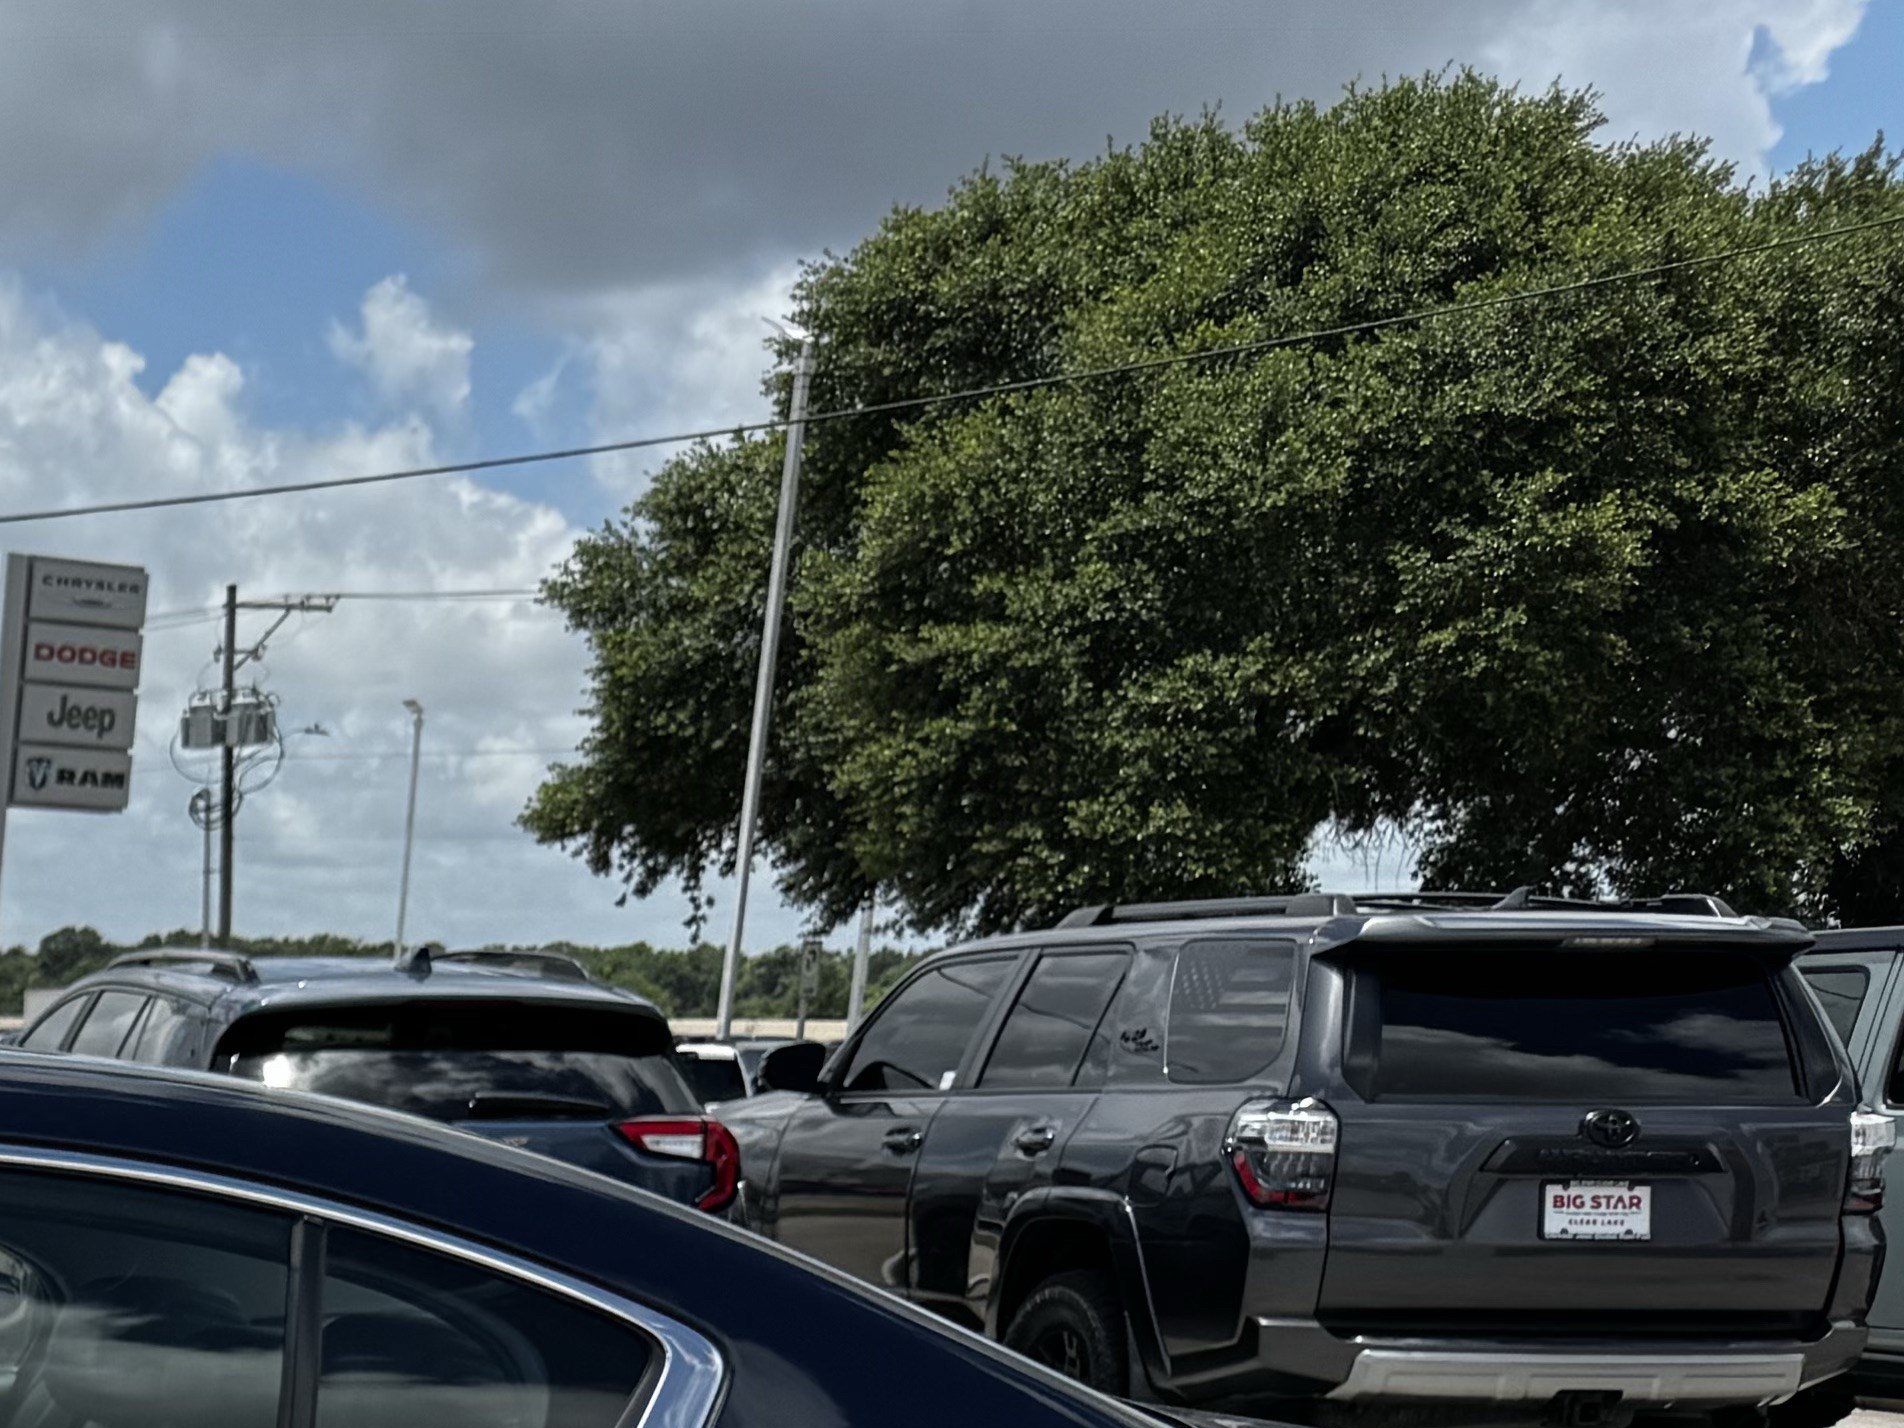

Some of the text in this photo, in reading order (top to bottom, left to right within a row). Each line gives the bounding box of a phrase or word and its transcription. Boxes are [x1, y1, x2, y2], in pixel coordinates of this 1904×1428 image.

[41, 575, 140, 594] CHRYSLER
[33, 643, 136, 670] DODGE
[46, 694, 116, 739] Jeep
[55, 768, 126, 790] RAM
[1552, 1194, 1643, 1211] BIG STAR
